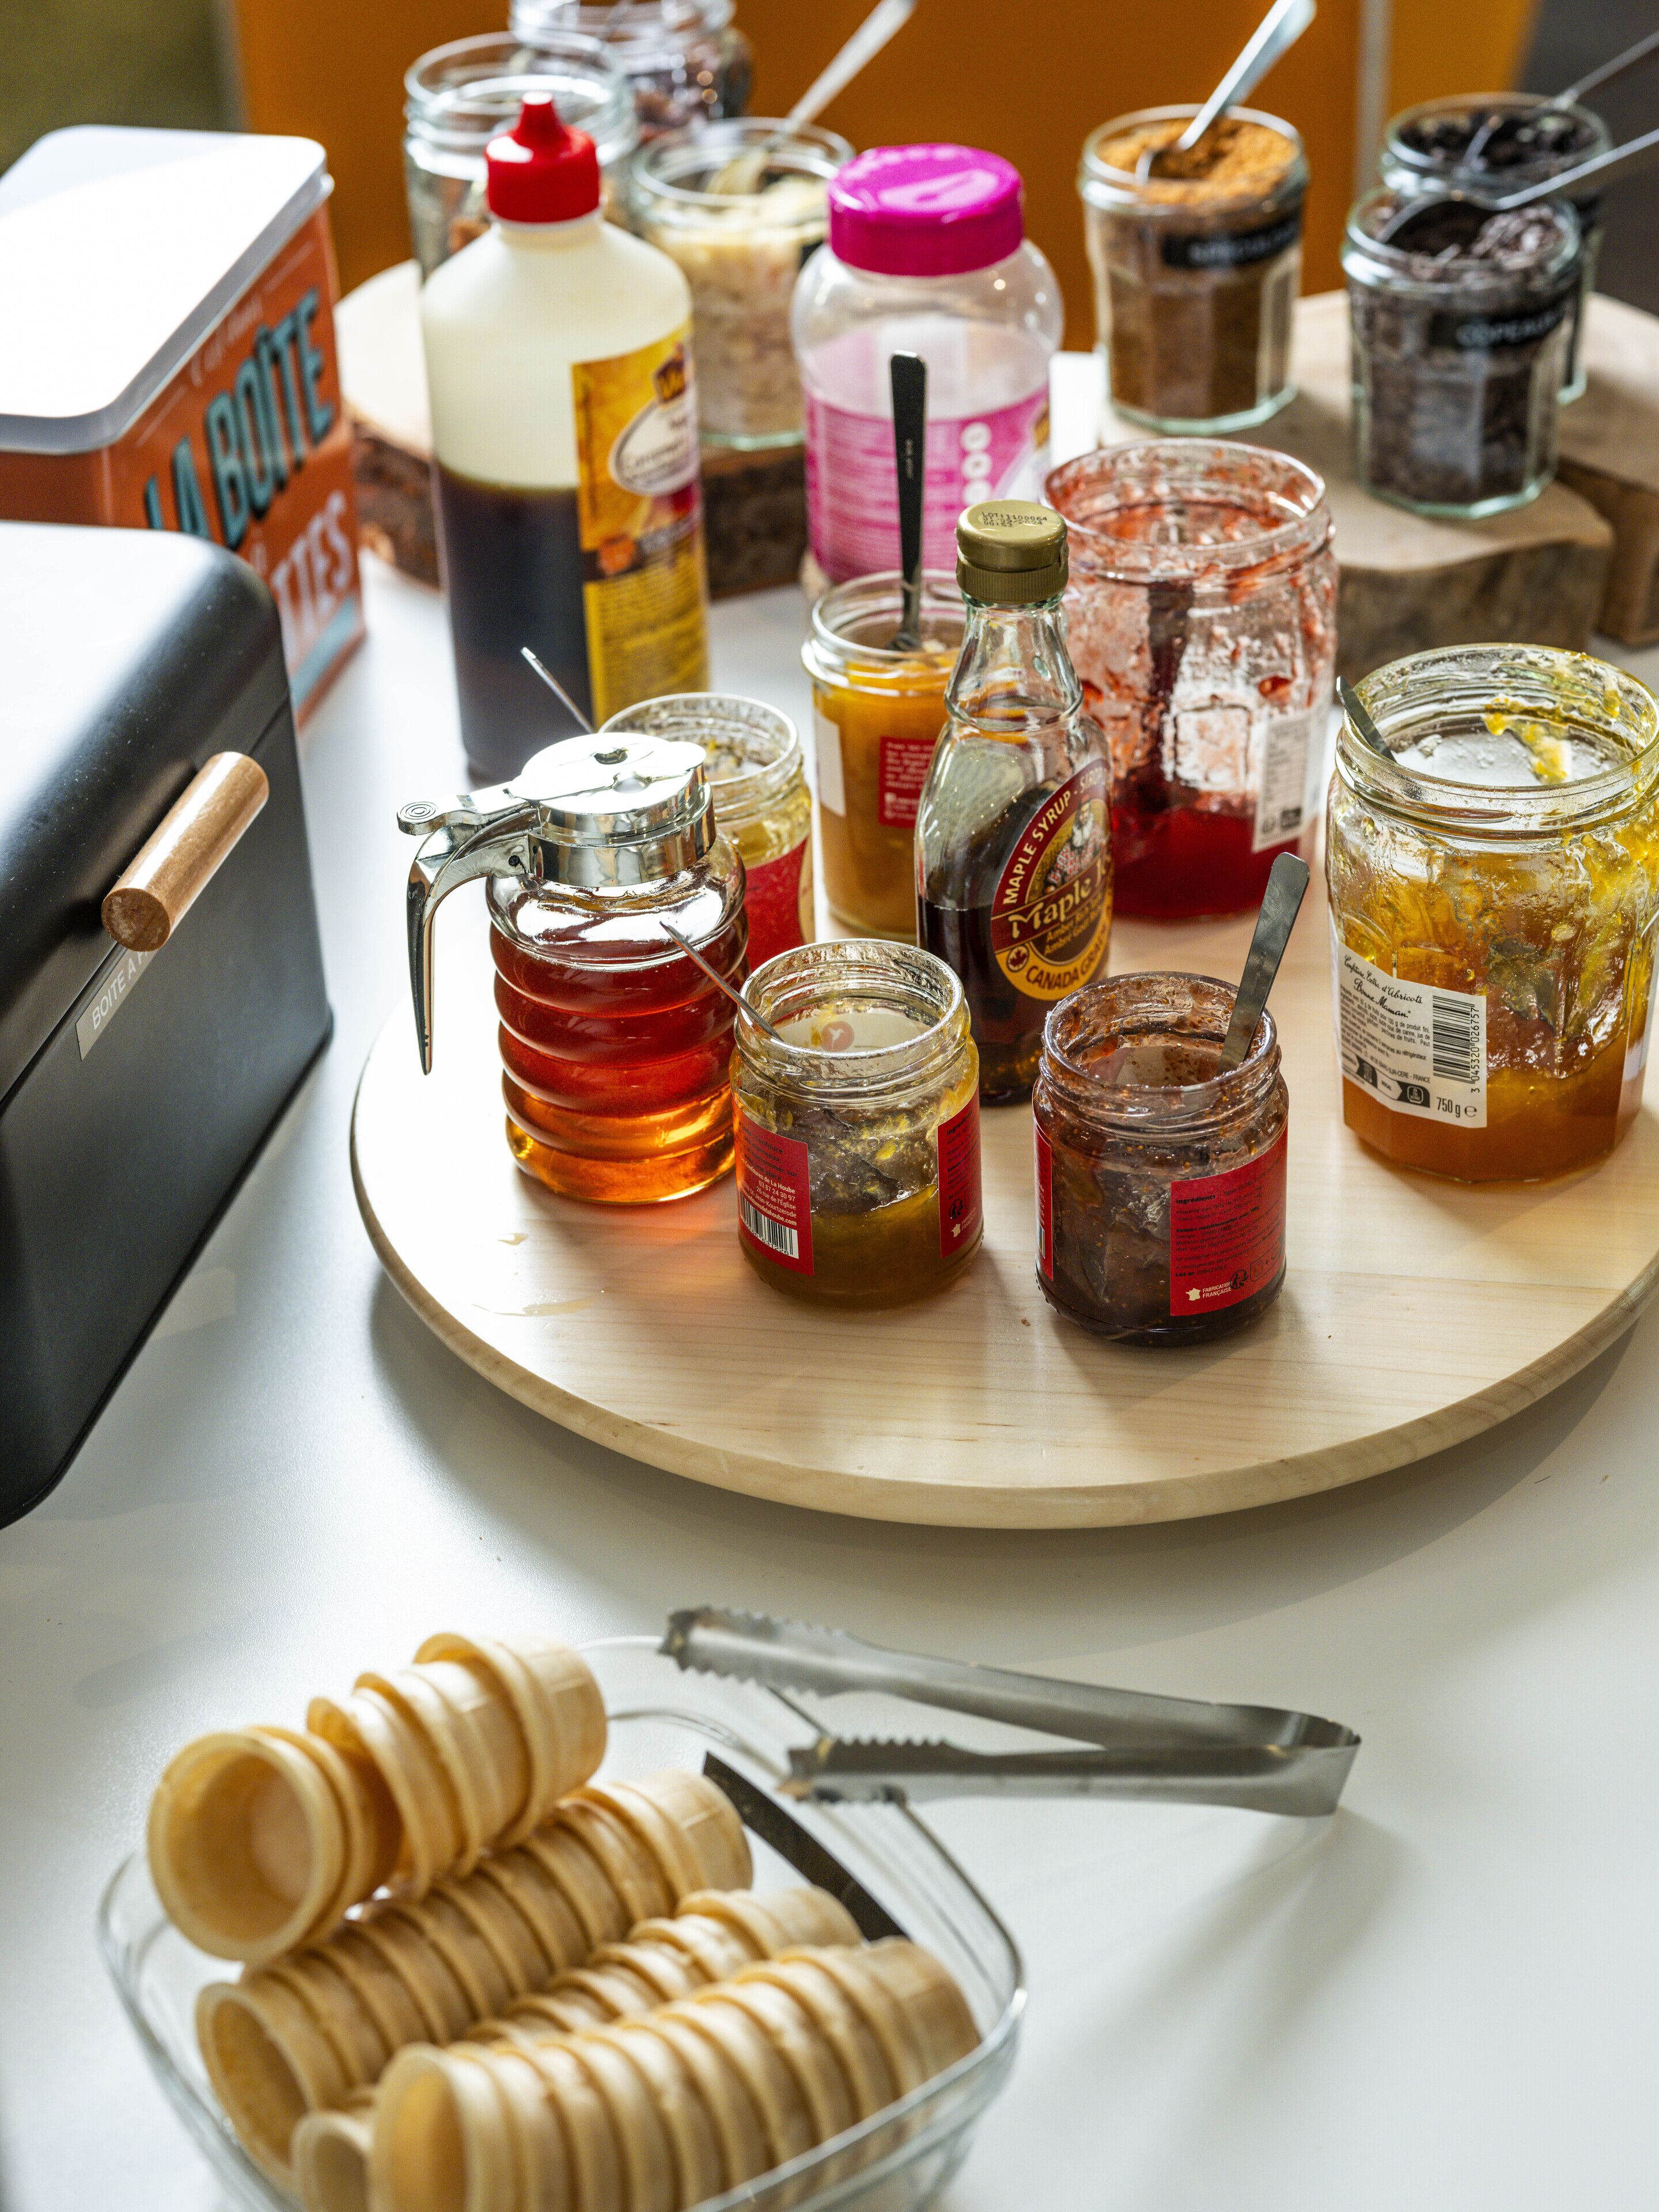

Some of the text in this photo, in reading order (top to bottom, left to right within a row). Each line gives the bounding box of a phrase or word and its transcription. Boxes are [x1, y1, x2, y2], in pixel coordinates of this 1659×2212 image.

[270, 489, 355, 660] TTES
[1003, 843, 1037, 905] MAPLE
[1033, 790, 1070, 842] SYRUP
[1009, 878, 1091, 938] Maple
[1026, 965, 1079, 990] CANADA
[1344, 955, 1365, 979] Confiture
[1366, 971, 1380, 988] Extra
[1382, 986, 1422, 1003] d'Abricots
[92, 969, 126, 1030] BOITE
[1354, 978, 1376, 1002] Bonne
[1471, 1007, 1479, 1043] 026757
[1471, 1047, 1480, 1081] 045320
[1413, 1074, 1430, 1084] FRANCE
[1437, 1097, 1453, 1113] 750
[1455, 1104, 1461, 1118] g
[751, 1152, 785, 1173] consommer
[766, 1171, 782, 1180] glace
[765, 1184, 771, 1192] 87
[772, 1188, 779, 1196] 24
[778, 1184, 796, 1194] Hoube
[778, 1198, 796, 1210] l'Église
[1202, 1286, 1232, 1299] FRANÇAISE
